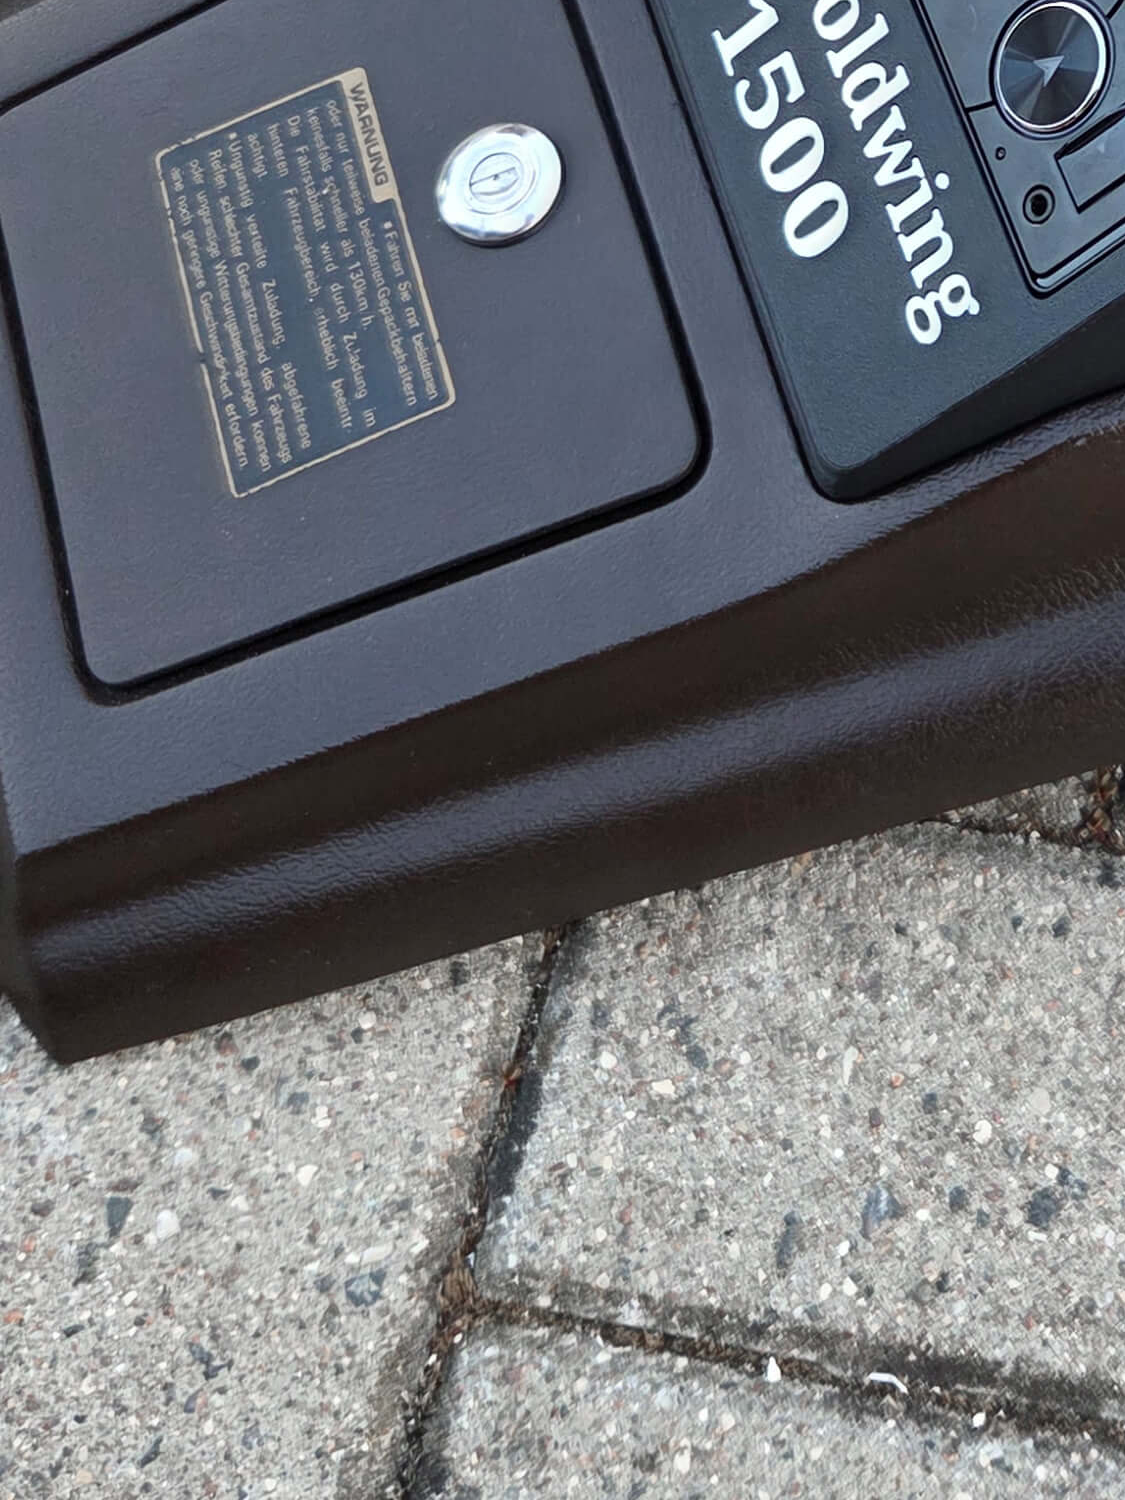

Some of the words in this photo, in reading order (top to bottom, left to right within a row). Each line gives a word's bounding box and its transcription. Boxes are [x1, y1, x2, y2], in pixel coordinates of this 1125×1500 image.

[324, 99, 342, 127] oder
[350, 83, 388, 185] WARNUNG
[266, 122, 288, 177] hinteren
[335, 132, 349, 153] nur
[188, 159, 204, 184] oder
[306, 106, 332, 171] keinesfalls
[323, 175, 347, 232] schneller
[340, 238, 356, 257] als
[341, 158, 364, 215] teilweise
[177, 194, 193, 225] noch
[181, 230, 205, 288] geringere
[286, 114, 302, 136] Die
[319, 241, 338, 272] wird
[329, 282, 351, 323] durch
[362, 406, 376, 427] im
[358, 217, 384, 286] beladenen
[384, 231, 404, 277] Fahren
[397, 280, 411, 302] Sie
[404, 306, 419, 328] mit
[219, 195, 242, 256] schlechter
[236, 262, 270, 363] Gesamtzustand
[260, 367, 274, 390] des
[267, 393, 291, 463] Fahrzeugs
[245, 213, 267, 268] verteilte
[280, 362, 310, 448] abgefahrene
[411, 332, 437, 399] beladenen
